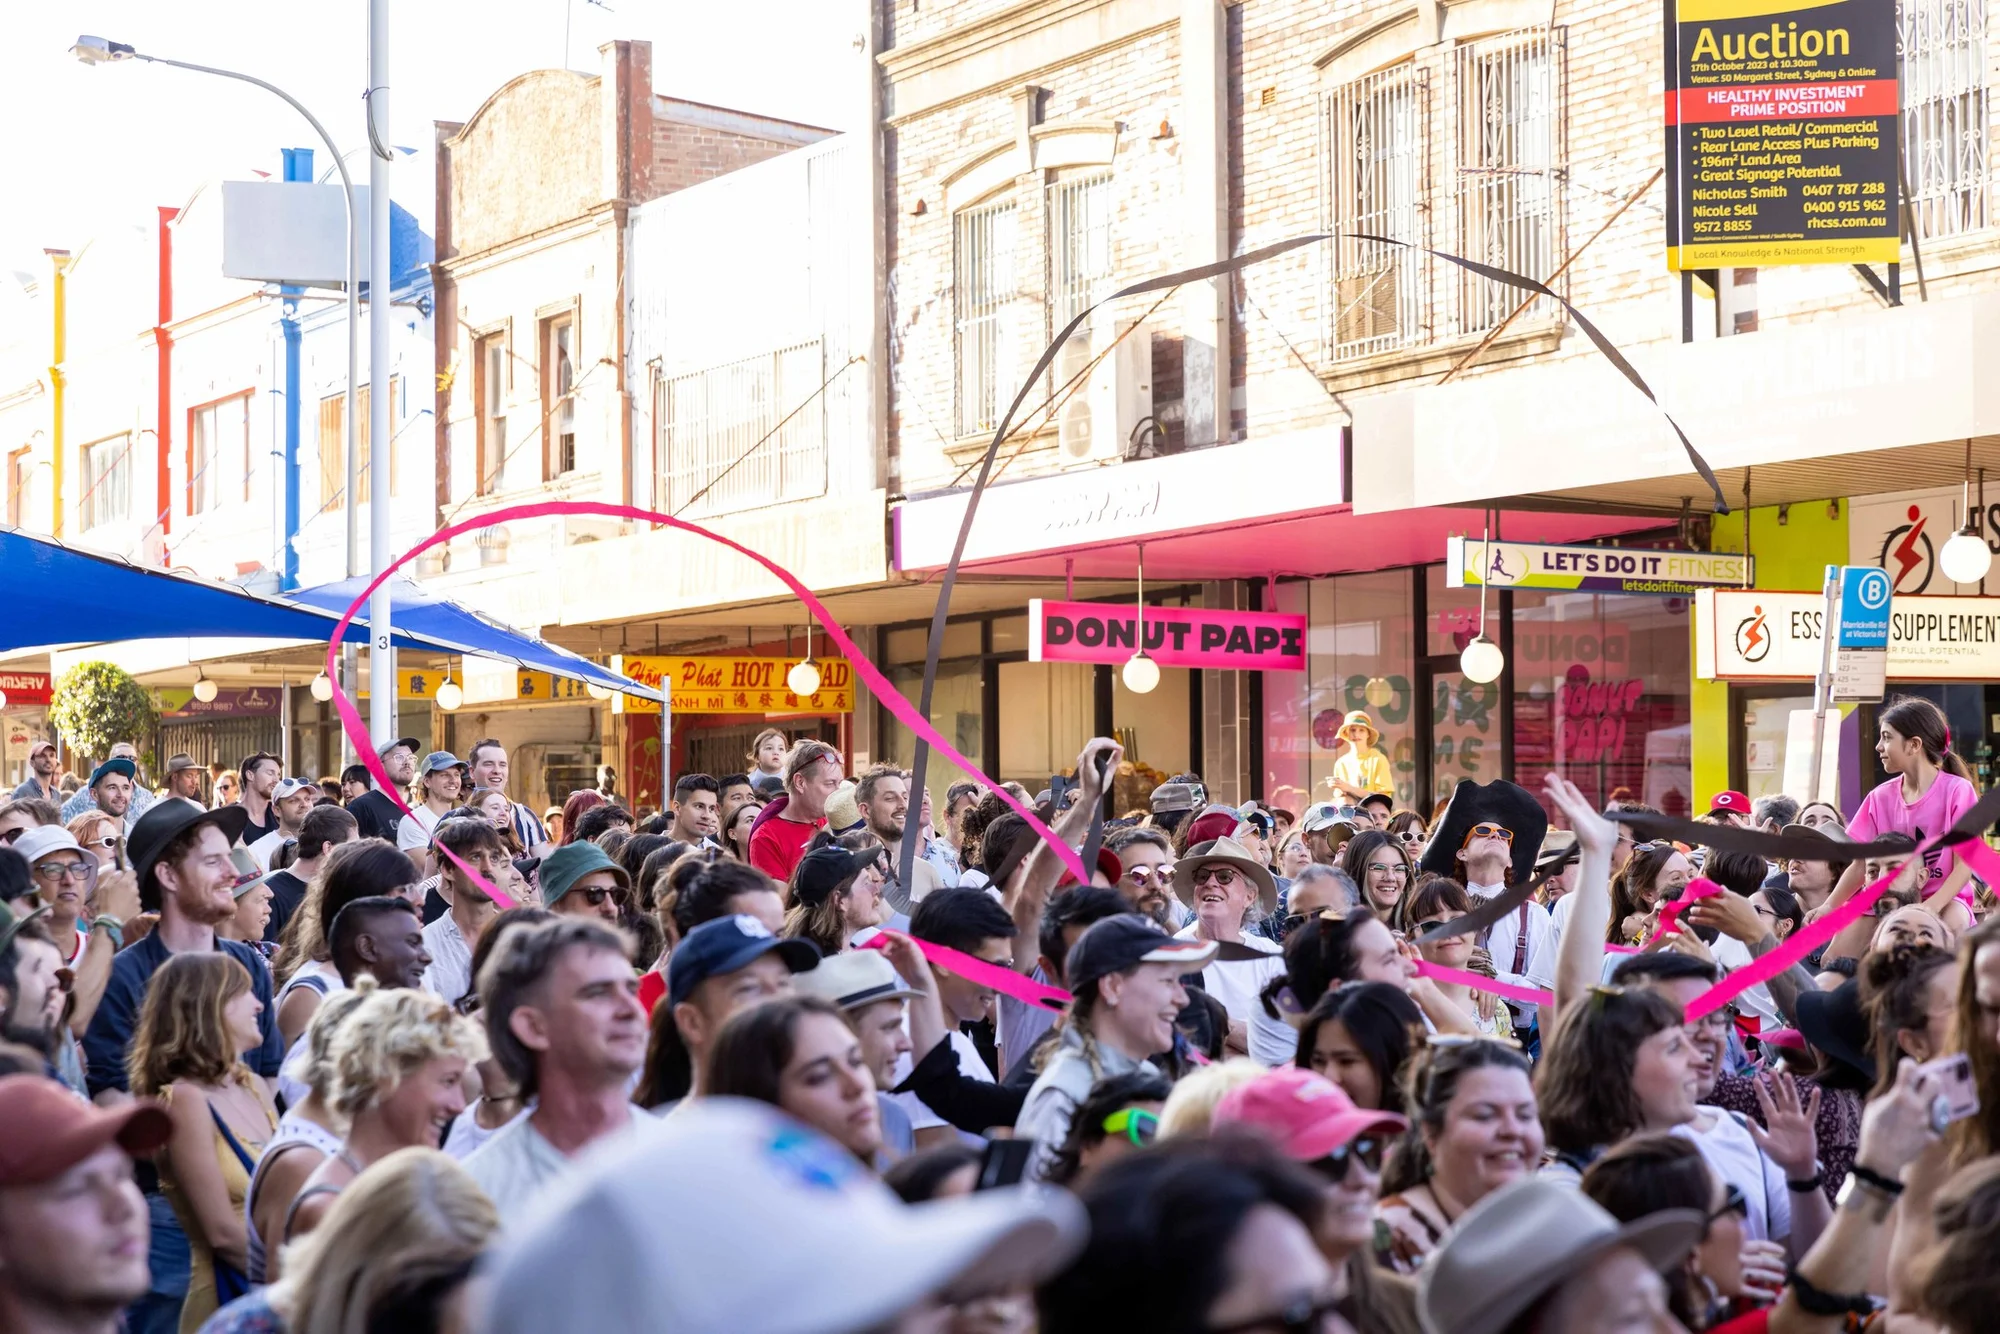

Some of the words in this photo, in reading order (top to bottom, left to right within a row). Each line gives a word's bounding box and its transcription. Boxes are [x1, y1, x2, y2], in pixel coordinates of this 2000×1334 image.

[1691, 22, 1850, 62] Auction
[1691, 64, 1709, 72] 17th
[1711, 62, 1745, 72] October
[1747, 61, 1768, 69] 2023
[1780, 59, 1817, 69] 10.30am
[1691, 75, 1719, 83] Venue:
[1720, 74, 1732, 82] 50
[1733, 72, 1773, 83] Margaret
[1775, 70, 1801, 81] Street,
[1804, 68, 1836, 80] Sydney
[1838, 69, 1846, 77] &
[1847, 68, 1876, 77] Online
[1707, 89, 1772, 104] HEALTHY
[1774, 85, 1866, 101] INVESTMENT
[1730, 103, 1775, 117] PRIME
[1778, 101, 1846, 115] POSITION
[1700, 127, 1726, 139] Two
[1728, 125, 1760, 138] Level
[1805, 120, 1879, 135] Commercial
[1701, 141, 1728, 153] Rear
[1731, 140, 1760, 152] Lane
[1761, 139, 1801, 151] Access
[1804, 137, 1830, 150] Plus
[1833, 135, 1879, 150] Parking
[1740, 154, 1771, 166] Land
[1773, 153, 1802, 165] Area
[1701, 170, 1734, 182] Great
[1736, 168, 1785, 181] Signage
[1787, 165, 1842, 179] Potential
[1692, 187, 1747, 200] Nicholas
[1750, 186, 1788, 198] Smith
[1802, 184, 1834, 197] 0407
[1837, 183, 1858, 196] 787
[1861, 182, 1886, 195] 288
[1692, 205, 1732, 218] Nicole
[1733, 203, 1758, 216] Sell
[1803, 201, 1836, 214] 0400
[1838, 200, 1860, 212] 915
[1863, 199, 1886, 211] 962
[1693, 221, 1721, 233] 9572
[1723, 220, 1752, 232] 8855
[1807, 216, 1887, 229] rhcss.com.au
[1694, 250, 1718, 260] Local
[1721, 247, 1772, 259] Knowledge
[1774, 248, 1781, 257] &
[1783, 246, 1824, 256] National
[1826, 245, 1865, 256] Strength
[1543, 551, 1599, 573] LET'S
[1605, 555, 1636, 574] DO
[1641, 557, 1661, 575] IT
[1842, 620, 1877, 629] Marrickville
[1878, 620, 1887, 629] Rd
[1892, 613, 2000, 643] SUPPLEMEN
[1046, 616, 1191, 651] DONUT
[1201, 624, 1302, 656] PAPI
[1845, 630, 1852, 638] at
[1853, 630, 1877, 638] Victoria
[1877, 630, 1886, 638] Rd
[378, 636, 388, 649] 3
[1901, 646, 1926, 655] FULL
[1929, 646, 1981, 656] POTENTIAL
[731, 662, 774, 687] HOT
[1556, 679, 1645, 716] DONUT
[1557, 715, 1627, 761] PAPI
